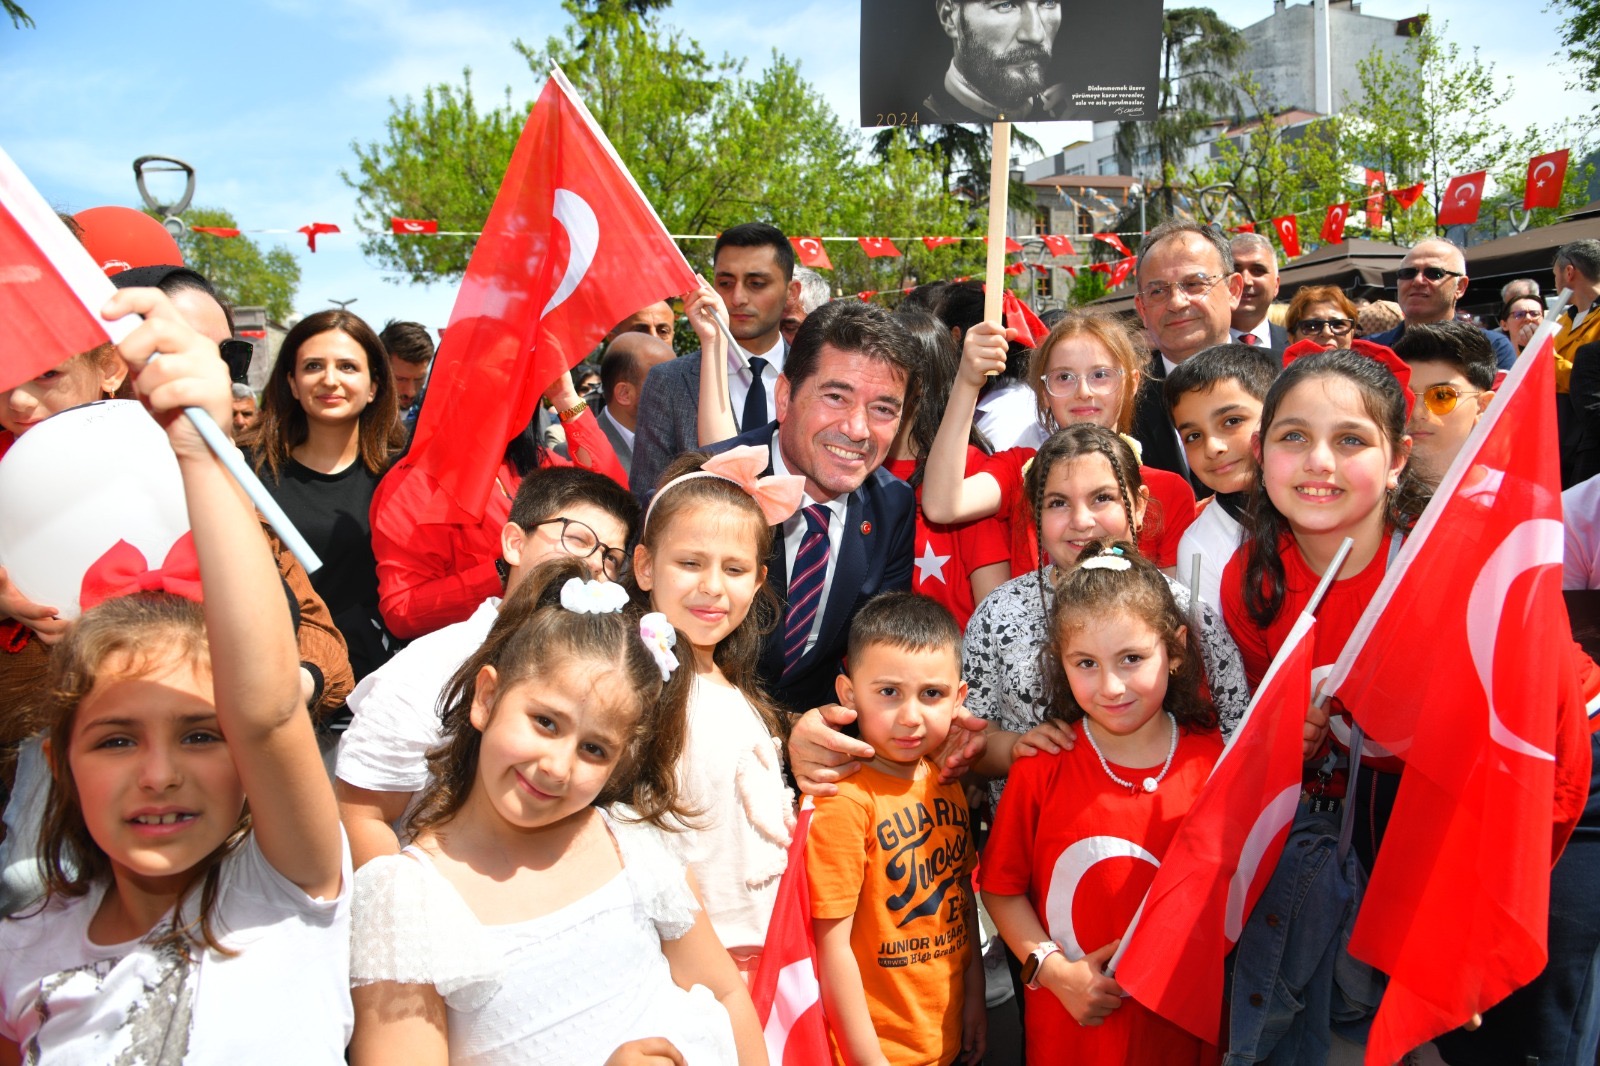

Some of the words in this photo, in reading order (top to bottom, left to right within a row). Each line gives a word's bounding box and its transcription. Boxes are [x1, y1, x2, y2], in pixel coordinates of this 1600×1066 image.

[1071, 92, 1101, 100] yürümeye
[876, 111, 919, 127] 2024
[878, 937, 930, 955] JUNIOR
[934, 923, 964, 947] WEAR
[910, 951, 932, 965] High
[933, 944, 956, 959] Grade
